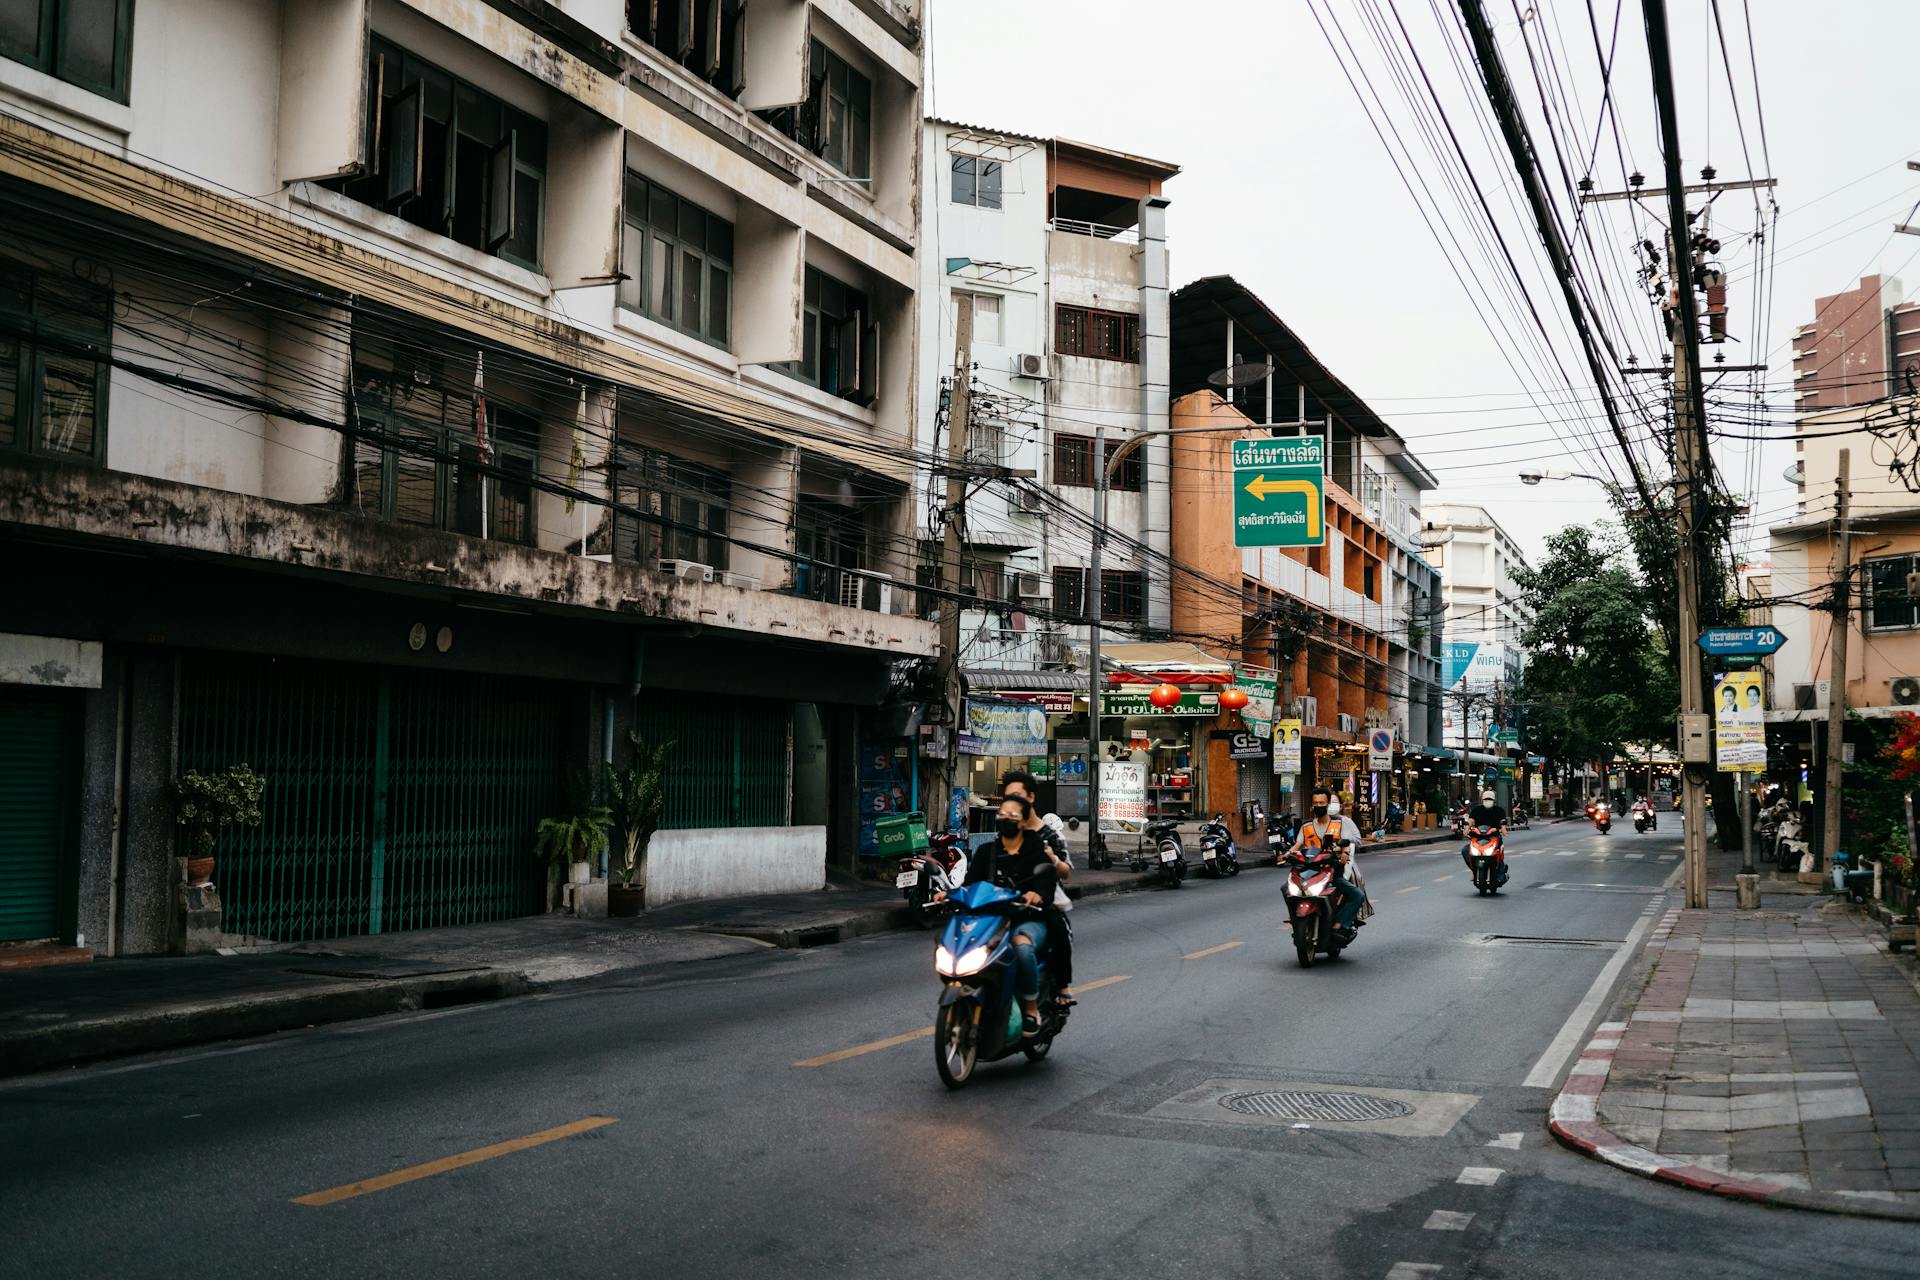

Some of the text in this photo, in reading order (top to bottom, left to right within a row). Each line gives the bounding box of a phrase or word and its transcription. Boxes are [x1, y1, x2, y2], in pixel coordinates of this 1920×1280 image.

[1235, 439, 1320, 465] เส้นทางลัด
[1238, 511, 1305, 529] สุทธิสารวินิจฉัย
[1757, 631, 1776, 646] 20
[883, 832, 906, 843] Grab
